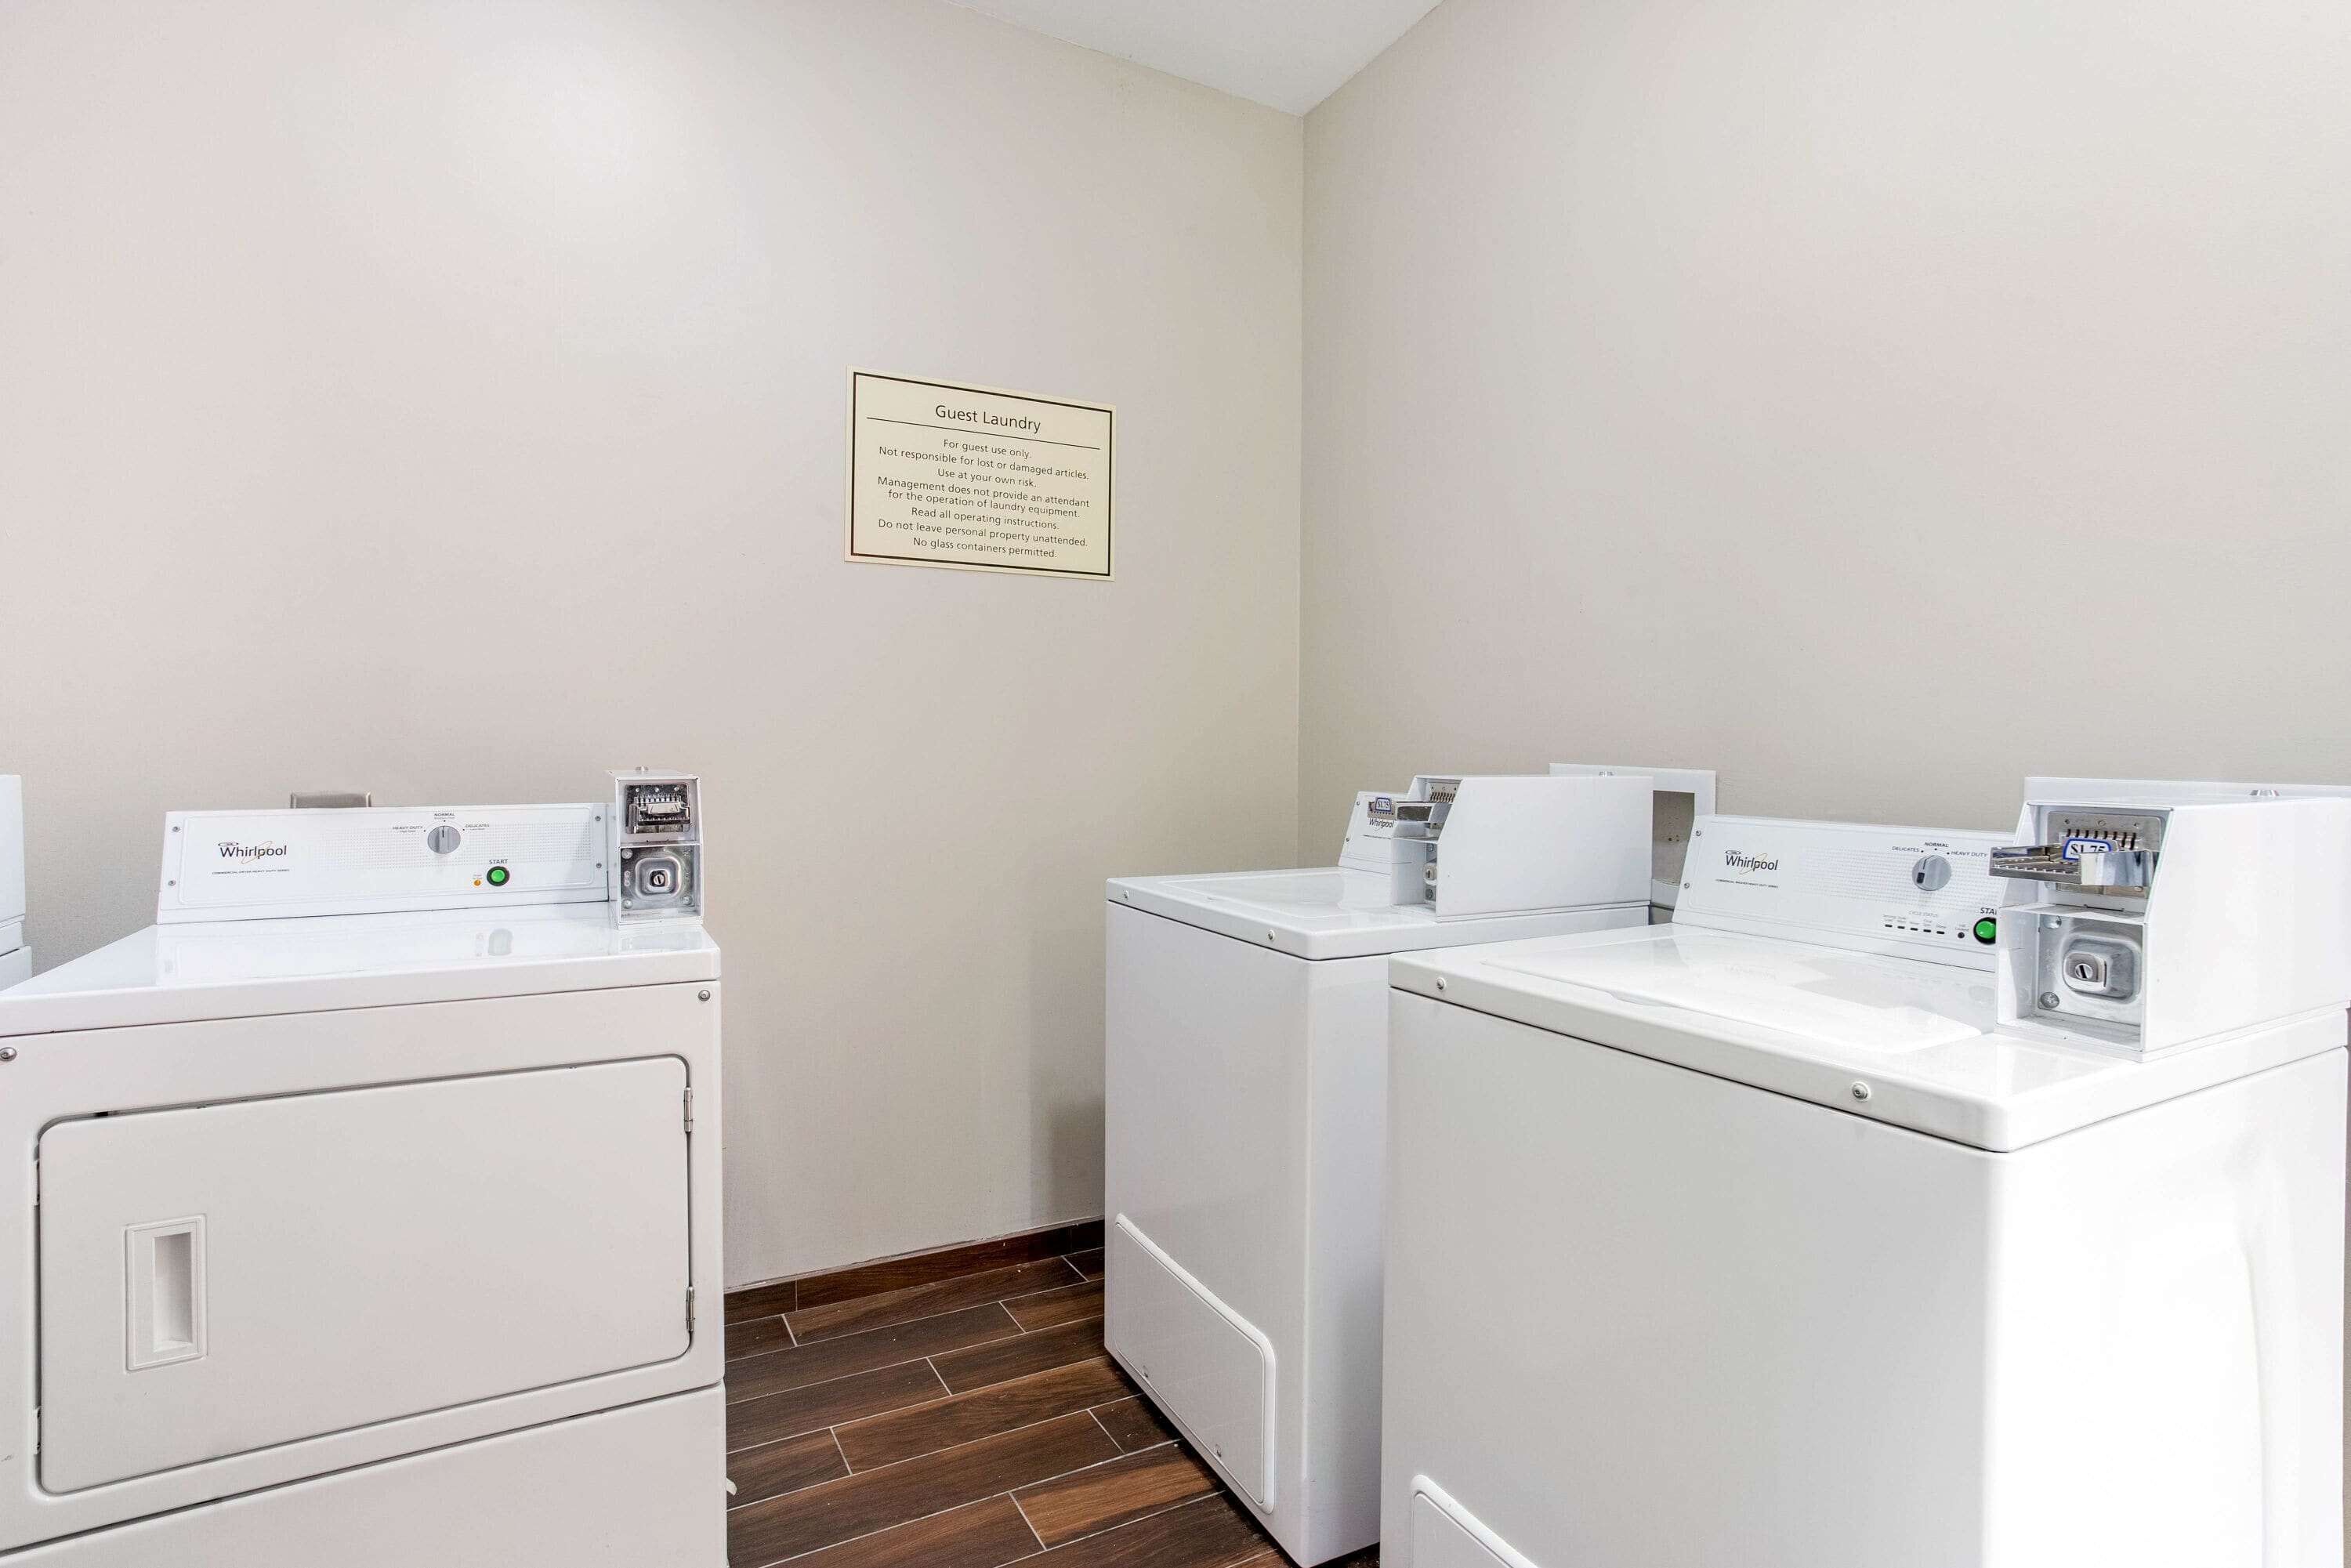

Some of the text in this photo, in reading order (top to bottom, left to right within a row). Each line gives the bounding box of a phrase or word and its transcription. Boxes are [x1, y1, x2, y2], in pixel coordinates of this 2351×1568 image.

[935, 404, 1041, 434] Guest Laundry
[943, 439, 1032, 460] For guest use only.
[879, 446, 898, 457] Not
[900, 450, 958, 464] responsible
[960, 455, 974, 465] for
[976, 457, 994, 468] lost
[1009, 462, 1052, 476] damaged
[1055, 469, 1089, 480] articles.
[937, 468, 1037, 487] Use at your own risk.
[877, 476, 945, 492] Management
[947, 483, 971, 495] does
[973, 488, 990, 497] not
[993, 490, 1028, 501] provide
[1045, 496, 1090, 508] attendant
[889, 488, 1081, 518] for the operation of laundry equipment.
[911, 506, 1060, 530] Read all operating instructions.
[878, 518, 1089, 547] Do not leave personal property unattended.
[913, 536, 1058, 558] No glass containers permitted.
[1369, 818, 1394, 828] Whirlpool
[219, 845, 288, 860] Whirlpool
[1726, 854, 1779, 872] Whirlpool
[1980, 907, 1998, 915] STA
